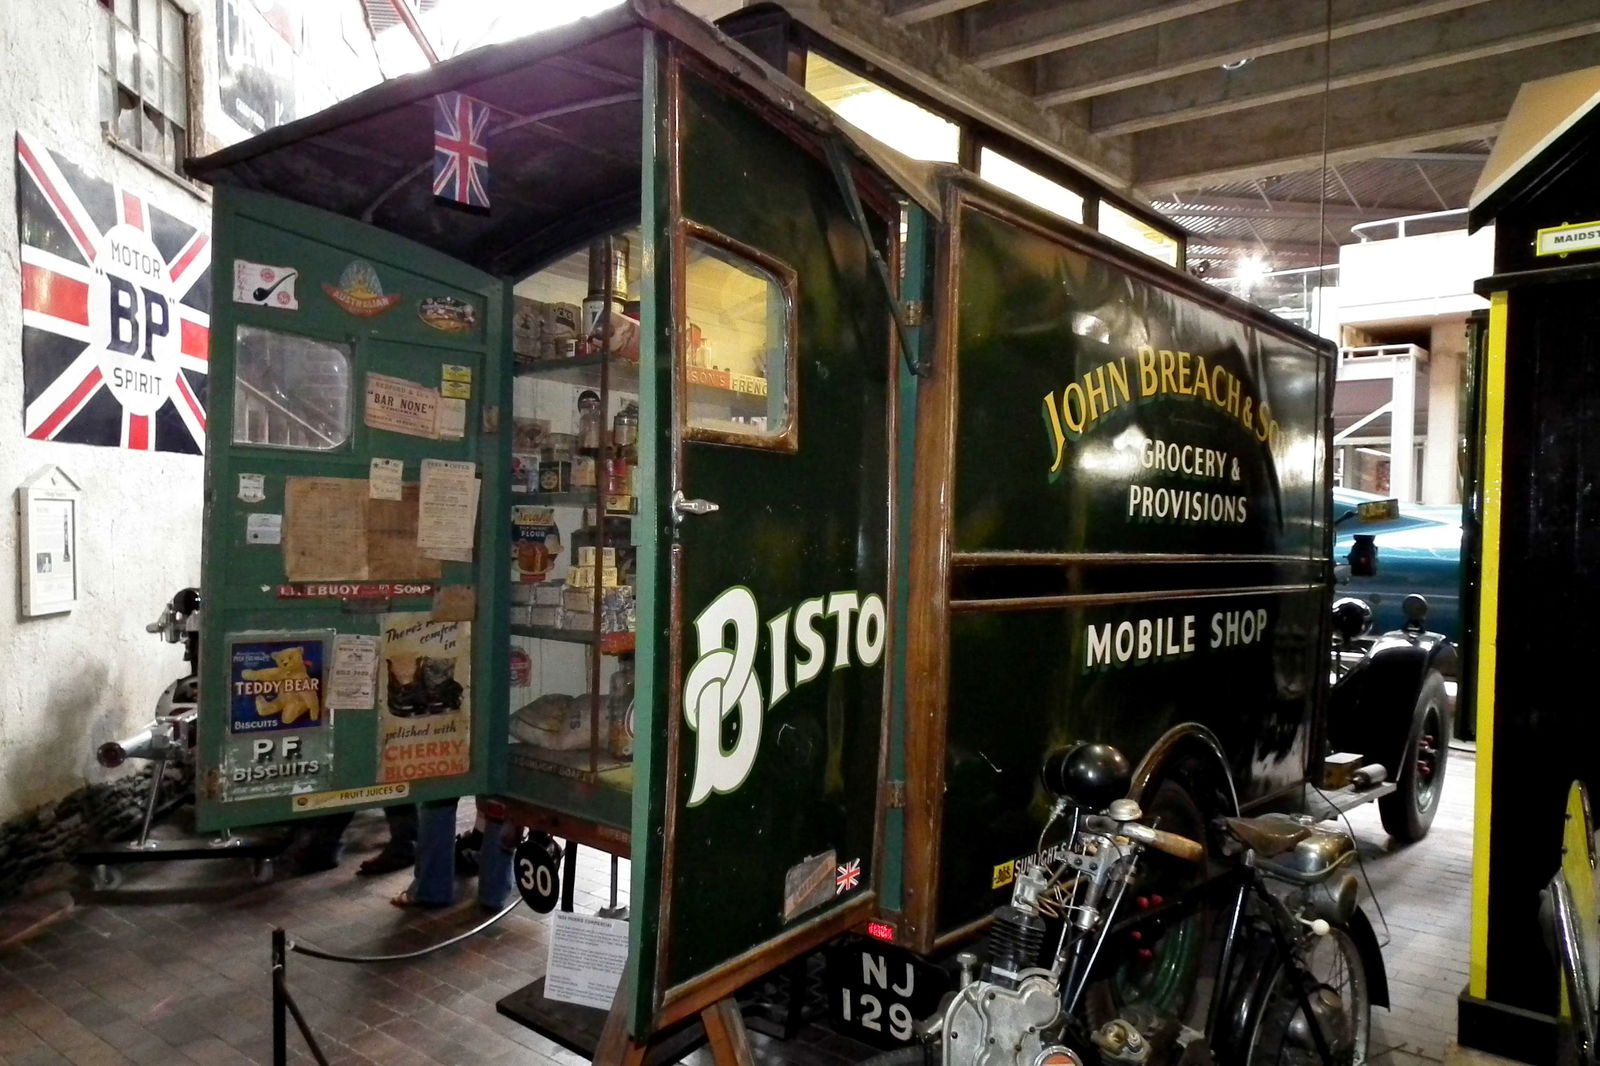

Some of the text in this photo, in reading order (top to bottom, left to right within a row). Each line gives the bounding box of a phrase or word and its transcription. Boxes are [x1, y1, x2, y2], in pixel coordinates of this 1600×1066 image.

[110, 239, 162, 280] MOTOR
[113, 366, 163, 396] SPIRIT
[1043, 356, 1131, 473] JOHN
[1137, 344, 1241, 417] BREACH
[1243, 395, 1253, 430] &
[1141, 438, 1241, 481] GROCERY &
[1129, 484, 1248, 523] PROVISIONS
[393, 584, 431, 595] SOAP
[1086, 608, 1268, 668] MOBILE SHOP
[235, 681, 282, 696] TEDDY
[284, 678, 320, 693] BEAR
[683, 584, 885, 807] BISTO
[234, 719, 279, 731] BISCUITS
[433, 719, 457, 736] with
[384, 740, 465, 762] CHERRY
[233, 760, 320, 783] BISCUITS
[384, 760, 467, 780] BLOSSOM
[339, 790, 364, 801] FRUIT
[366, 786, 394, 798] JUICES
[520, 858, 552, 897] 30
[861, 952, 915, 998] NJ
[842, 988, 912, 1041] 129
